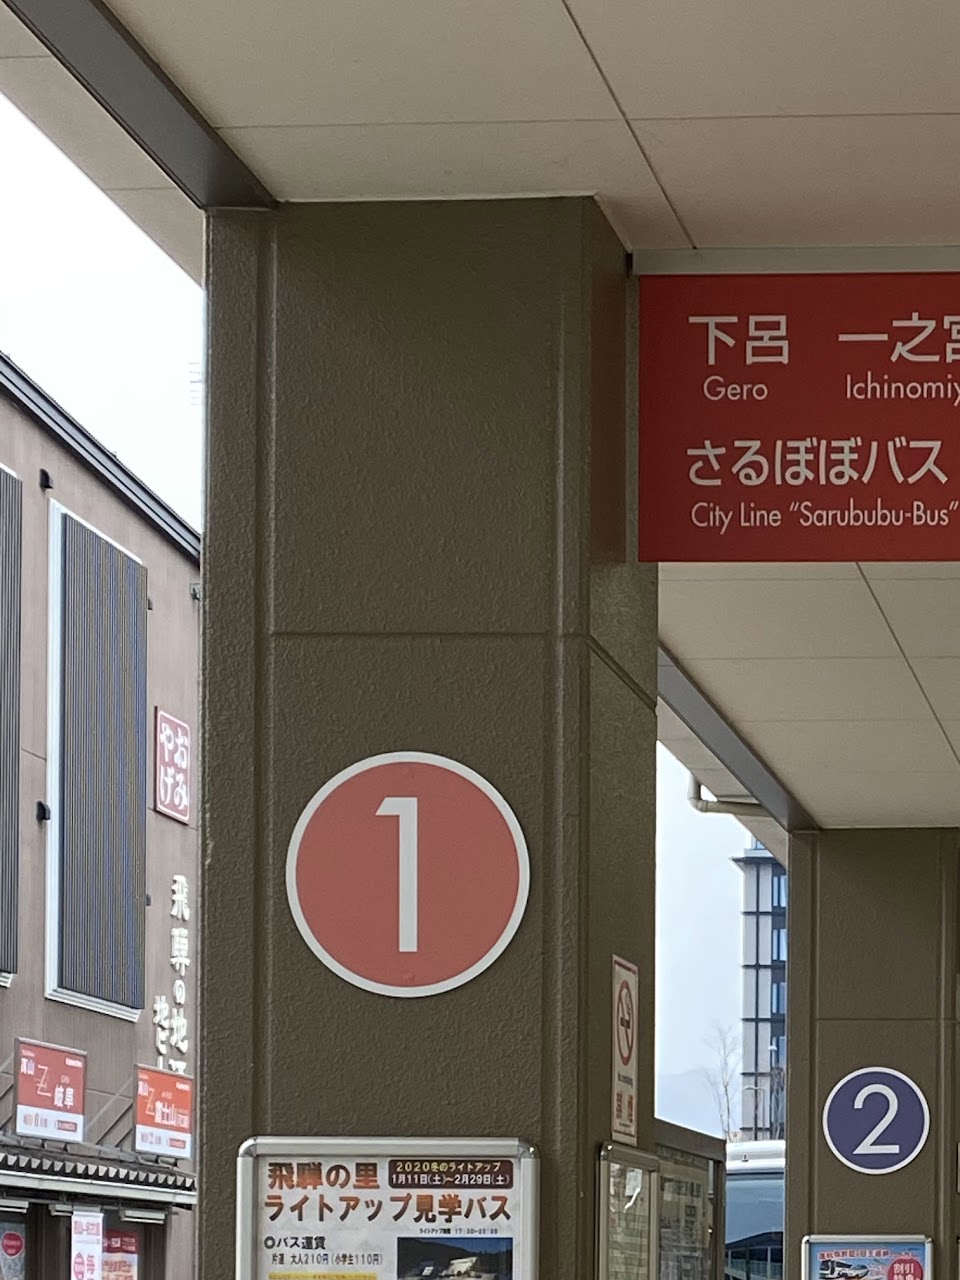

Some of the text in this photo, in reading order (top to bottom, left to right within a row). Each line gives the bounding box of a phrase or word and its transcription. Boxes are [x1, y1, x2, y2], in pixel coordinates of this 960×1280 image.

[688, 315, 788, 365] 下呂
[703, 375, 768, 400] Gero
[687, 436, 948, 486] さるぼぼバス
[692, 502, 733, 534] City
[740, 502, 781, 526] Line
[375, 797, 417, 952] 1
[853, 1084, 899, 1154] 2
[268, 1162, 380, 1190] 飛騨の里
[264, 1193, 511, 1223] ライトアップ見学バス
